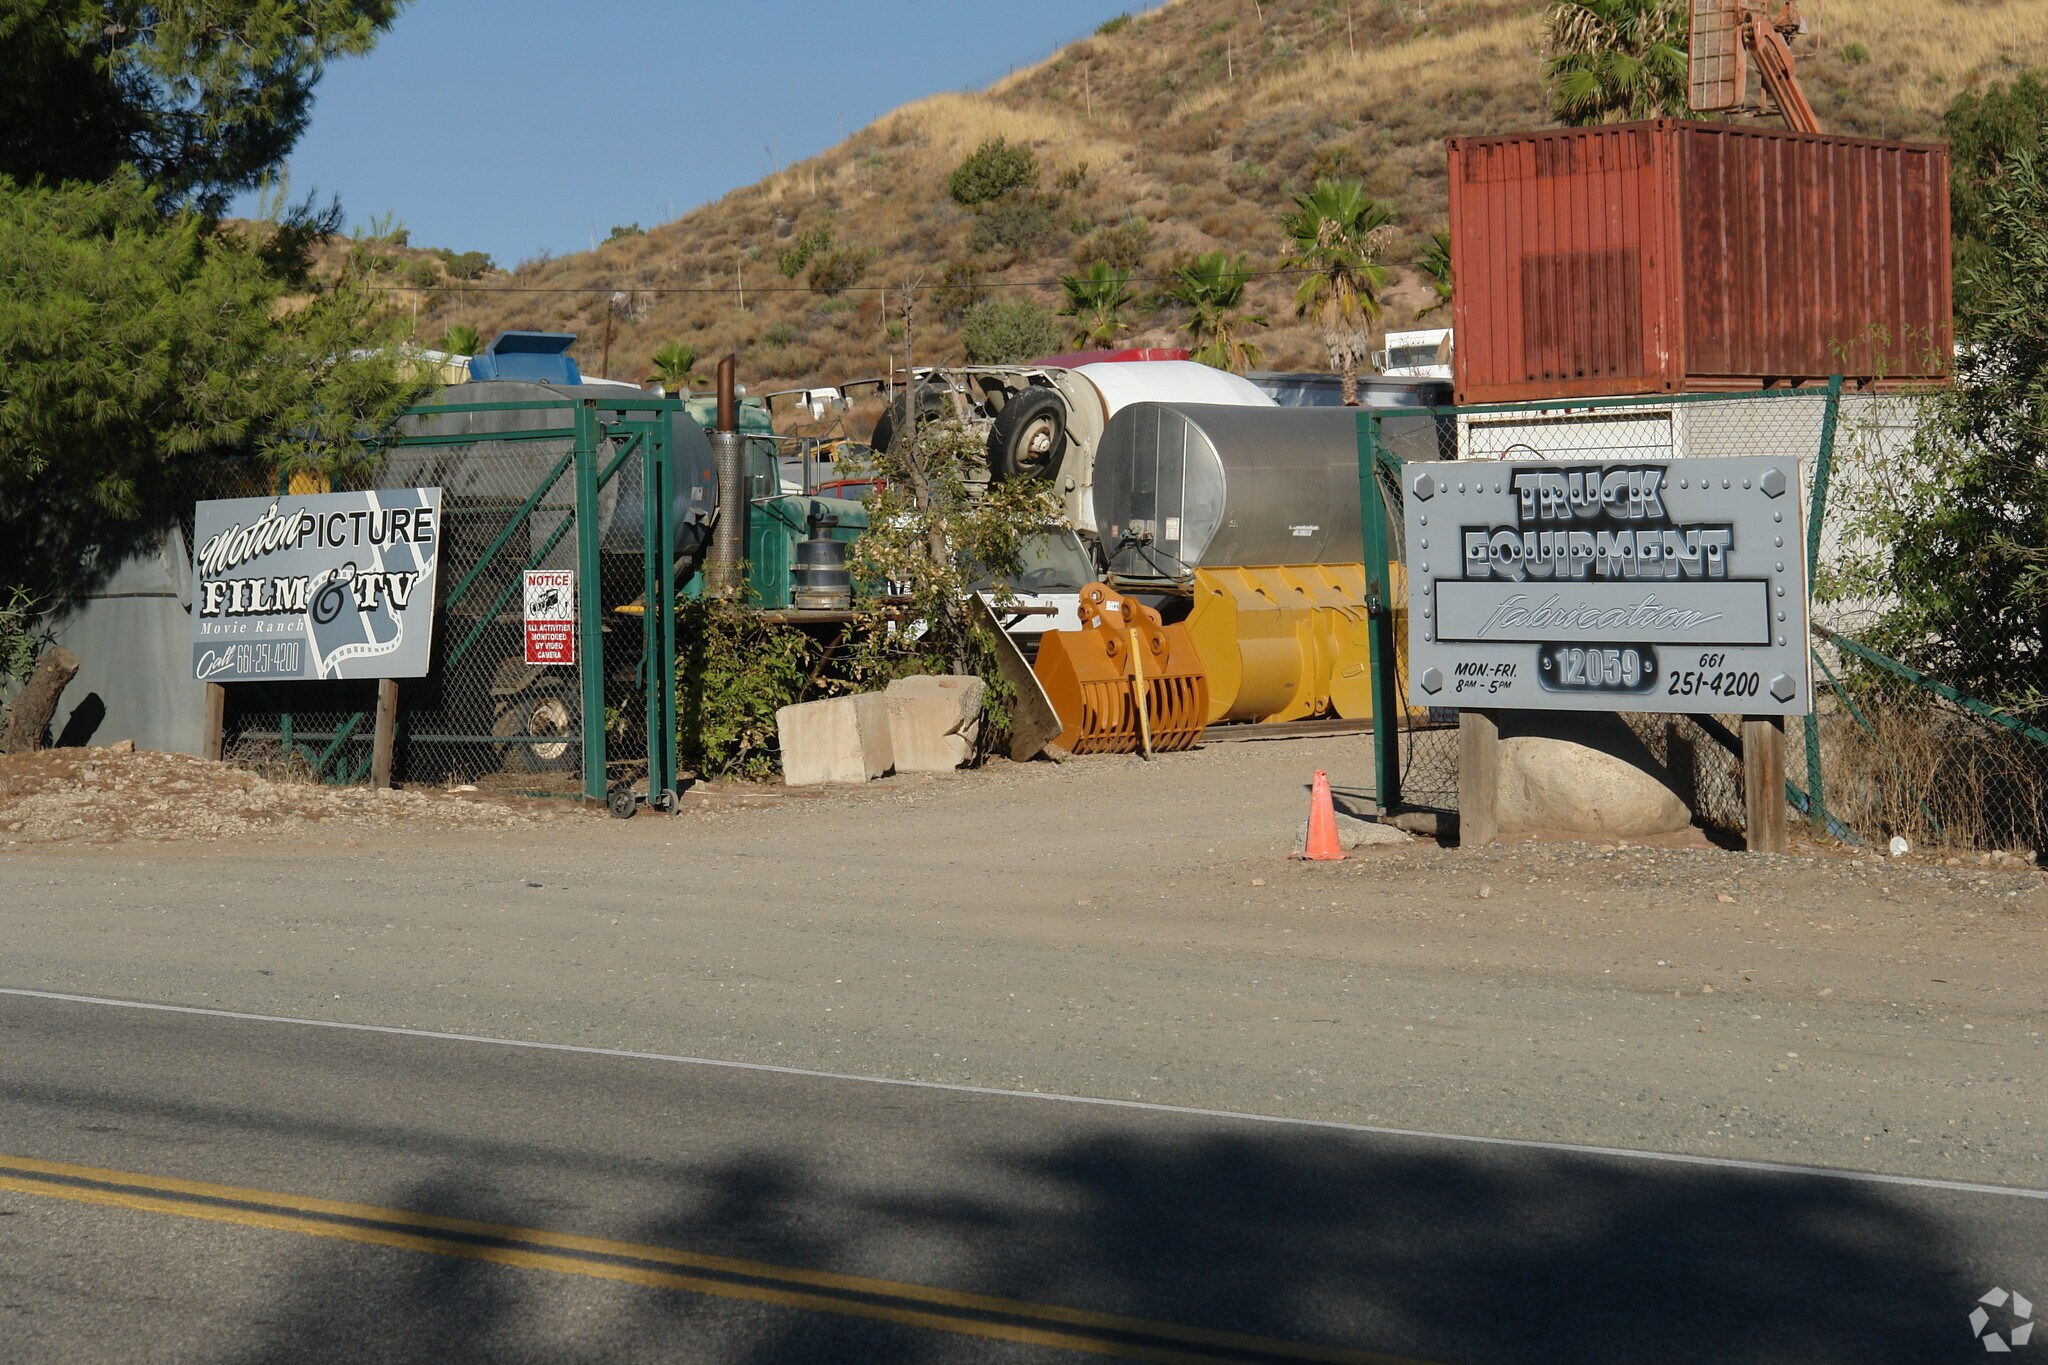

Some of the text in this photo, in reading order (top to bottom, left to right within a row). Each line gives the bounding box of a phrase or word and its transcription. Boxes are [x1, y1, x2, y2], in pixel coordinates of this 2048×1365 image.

[1513, 469, 1664, 520] TRUCK
[198, 498, 434, 579] Motion PICTURE
[1464, 529, 1730, 582] EQUIPMENT
[528, 575, 569, 586] NOTICE
[200, 561, 419, 624] FILM & TV
[200, 618, 305, 635] Movie Ranch
[528, 624, 571, 632] ALL ACTIVITIES
[535, 642, 563, 650] BY VIDEO
[196, 642, 299, 679] Call 661-251-4200
[1454, 662, 1518, 679] MON.-FRI.
[1555, 647, 1641, 686] 12059
[1699, 653, 1726, 669] 661
[1455, 679, 1478, 694] 8AM
[1488, 680, 1512, 694] 5PM
[1667, 671, 1761, 698] 251-4200
